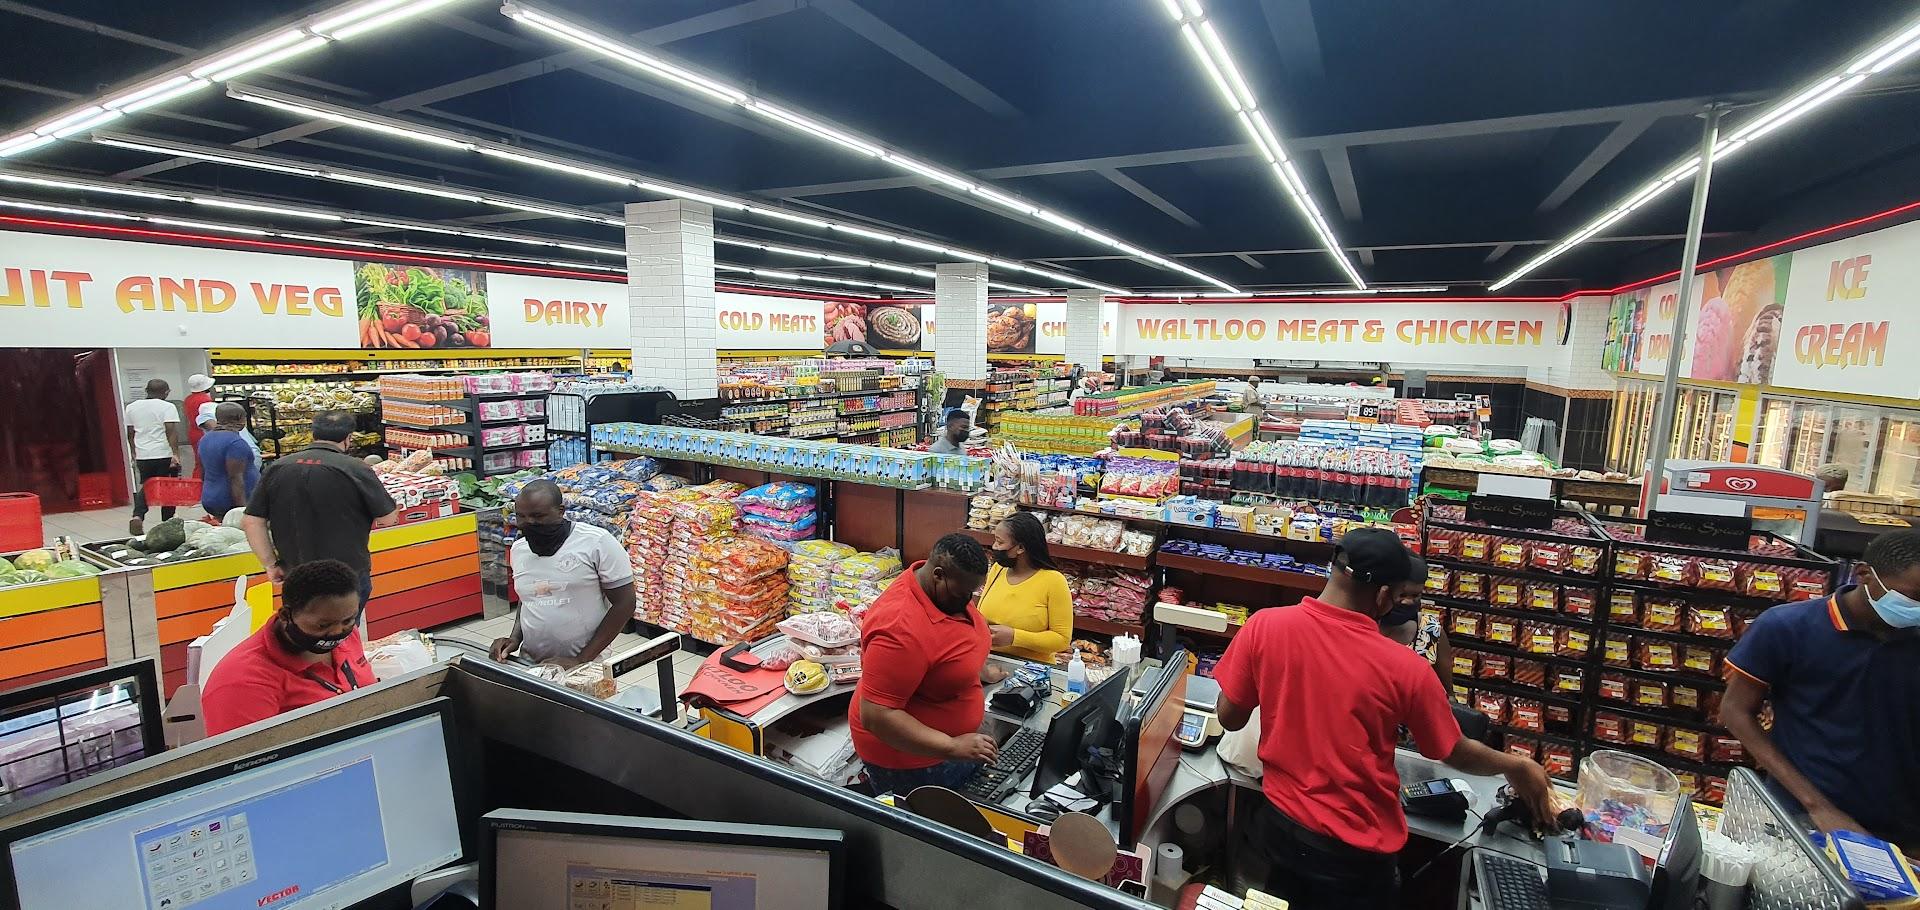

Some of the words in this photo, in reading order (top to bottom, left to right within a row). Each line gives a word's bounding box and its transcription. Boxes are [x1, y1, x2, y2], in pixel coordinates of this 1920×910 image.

[1826, 254, 1872, 302] ICE
[115, 276, 237, 313] AND
[250, 282, 344, 317] VEG
[524, 298, 608, 327] DAIRY
[719, 310, 763, 330] COLD
[769, 313, 816, 333] MEATS
[1136, 318, 1266, 342] WALTLOO
[1396, 320, 1544, 346] CHICKEN
[1794, 320, 1890, 370] CREAM
[233, 753, 279, 771] lenovo
[257, 884, 300, 907] VECTOR
